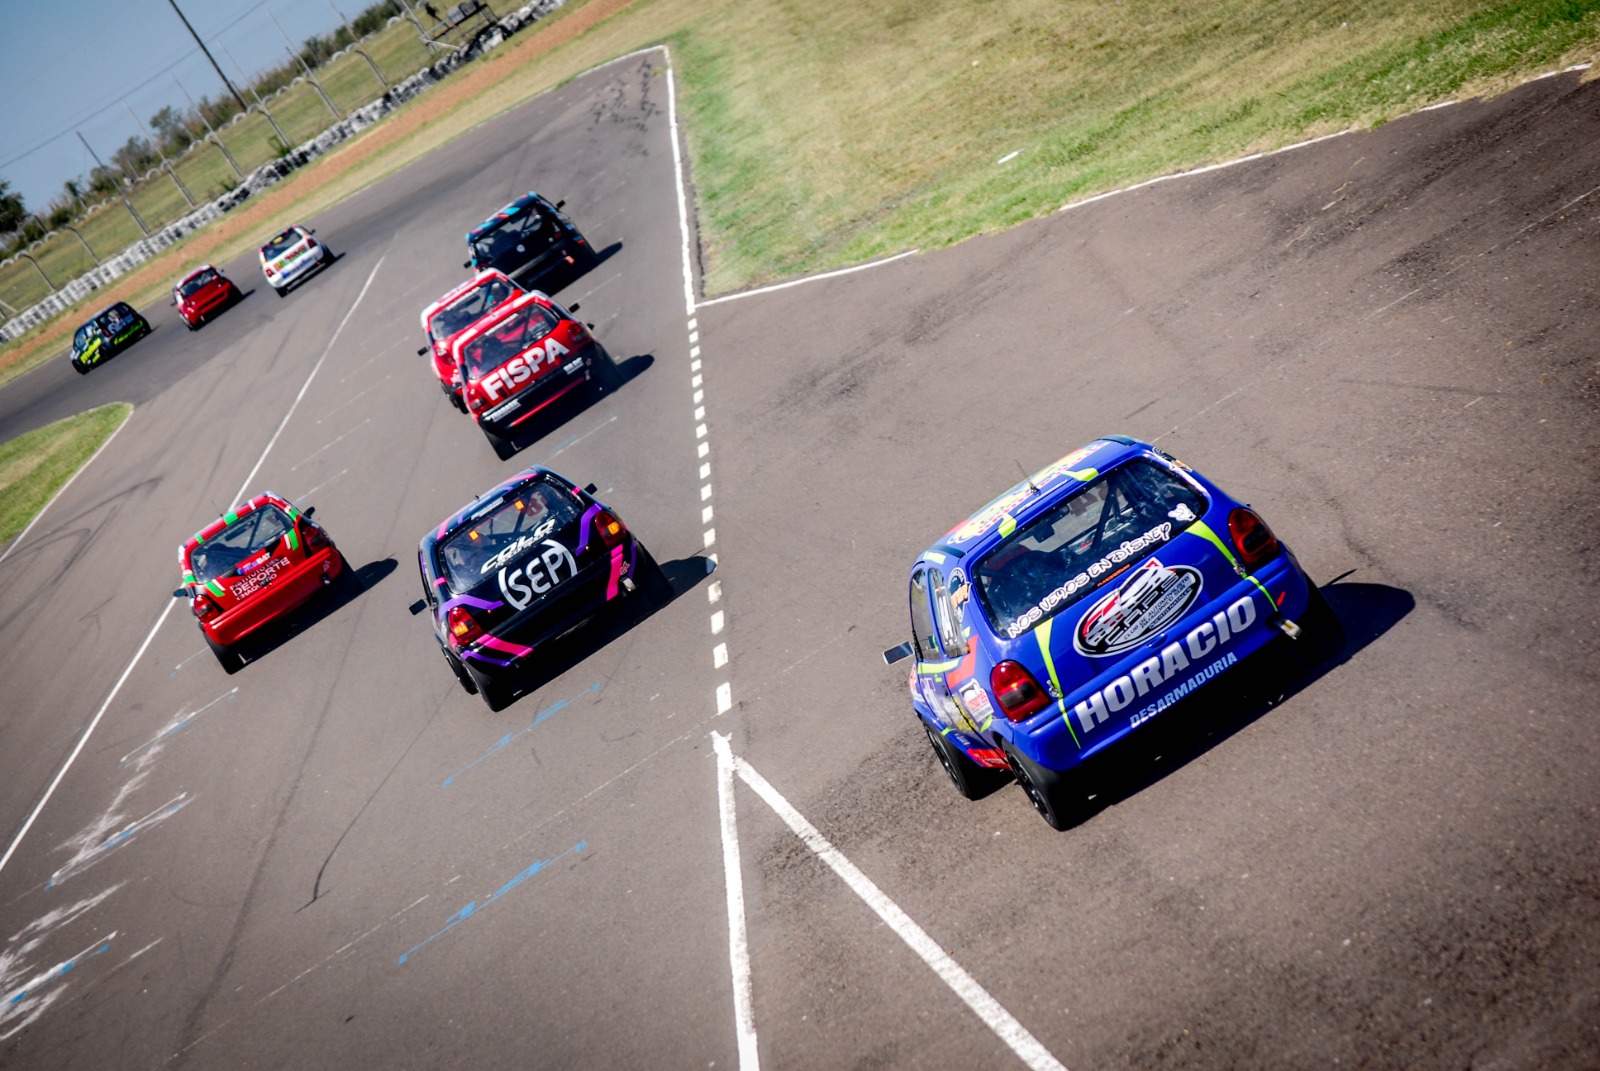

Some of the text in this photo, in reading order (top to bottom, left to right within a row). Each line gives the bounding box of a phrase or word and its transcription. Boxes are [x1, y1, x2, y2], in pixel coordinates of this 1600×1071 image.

[481, 337, 570, 401] FISPA
[232, 557, 290, 596] DEPORTE
[508, 547, 564, 604] SEP
[1007, 605, 1043, 638] NOS
[1040, 572, 1091, 611] VEMOS
[1088, 558, 1112, 578] EN
[1124, 625, 1139, 640] CLUB
[1139, 617, 1148, 626] DE
[1074, 595, 1257, 733] HORACIO
[1129, 651, 1239, 729] DESARMADURIA
